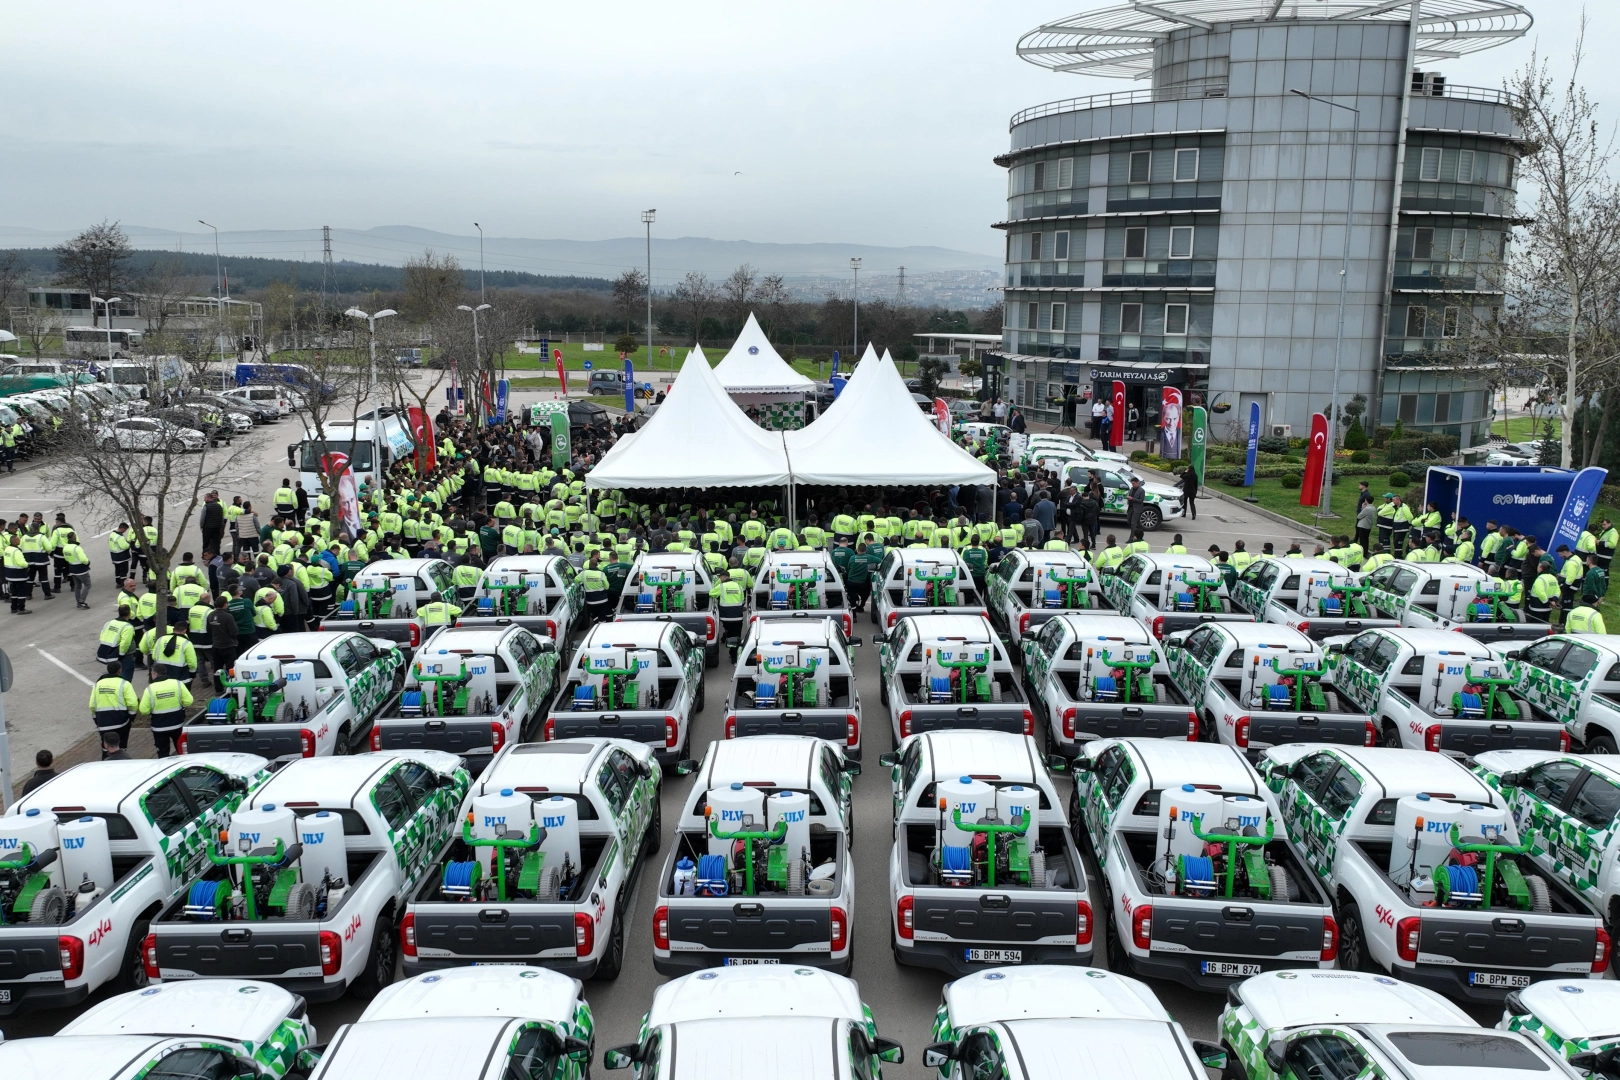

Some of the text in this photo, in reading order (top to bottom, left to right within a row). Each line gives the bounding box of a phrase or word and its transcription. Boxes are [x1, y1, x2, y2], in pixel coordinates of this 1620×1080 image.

[1123, 372, 1147, 380] PEYZAJ
[471, 666, 487, 675] ULV
[1447, 666, 1464, 675] PLV
[543, 815, 566, 827] ULV
[722, 810, 743, 821] PLV
[784, 810, 805, 822] ULV
[1238, 815, 1261, 827] ULV
[1426, 821, 1452, 833] PLV
[63, 837, 85, 849] ULV
[302, 832, 324, 844] ULV
[970, 950, 1021, 961] 16 BPM 594
[729, 958, 738, 966] 16
[1207, 962, 1259, 976] 16 BPM 874
[1475, 973, 1529, 987] 16 BPM 565
